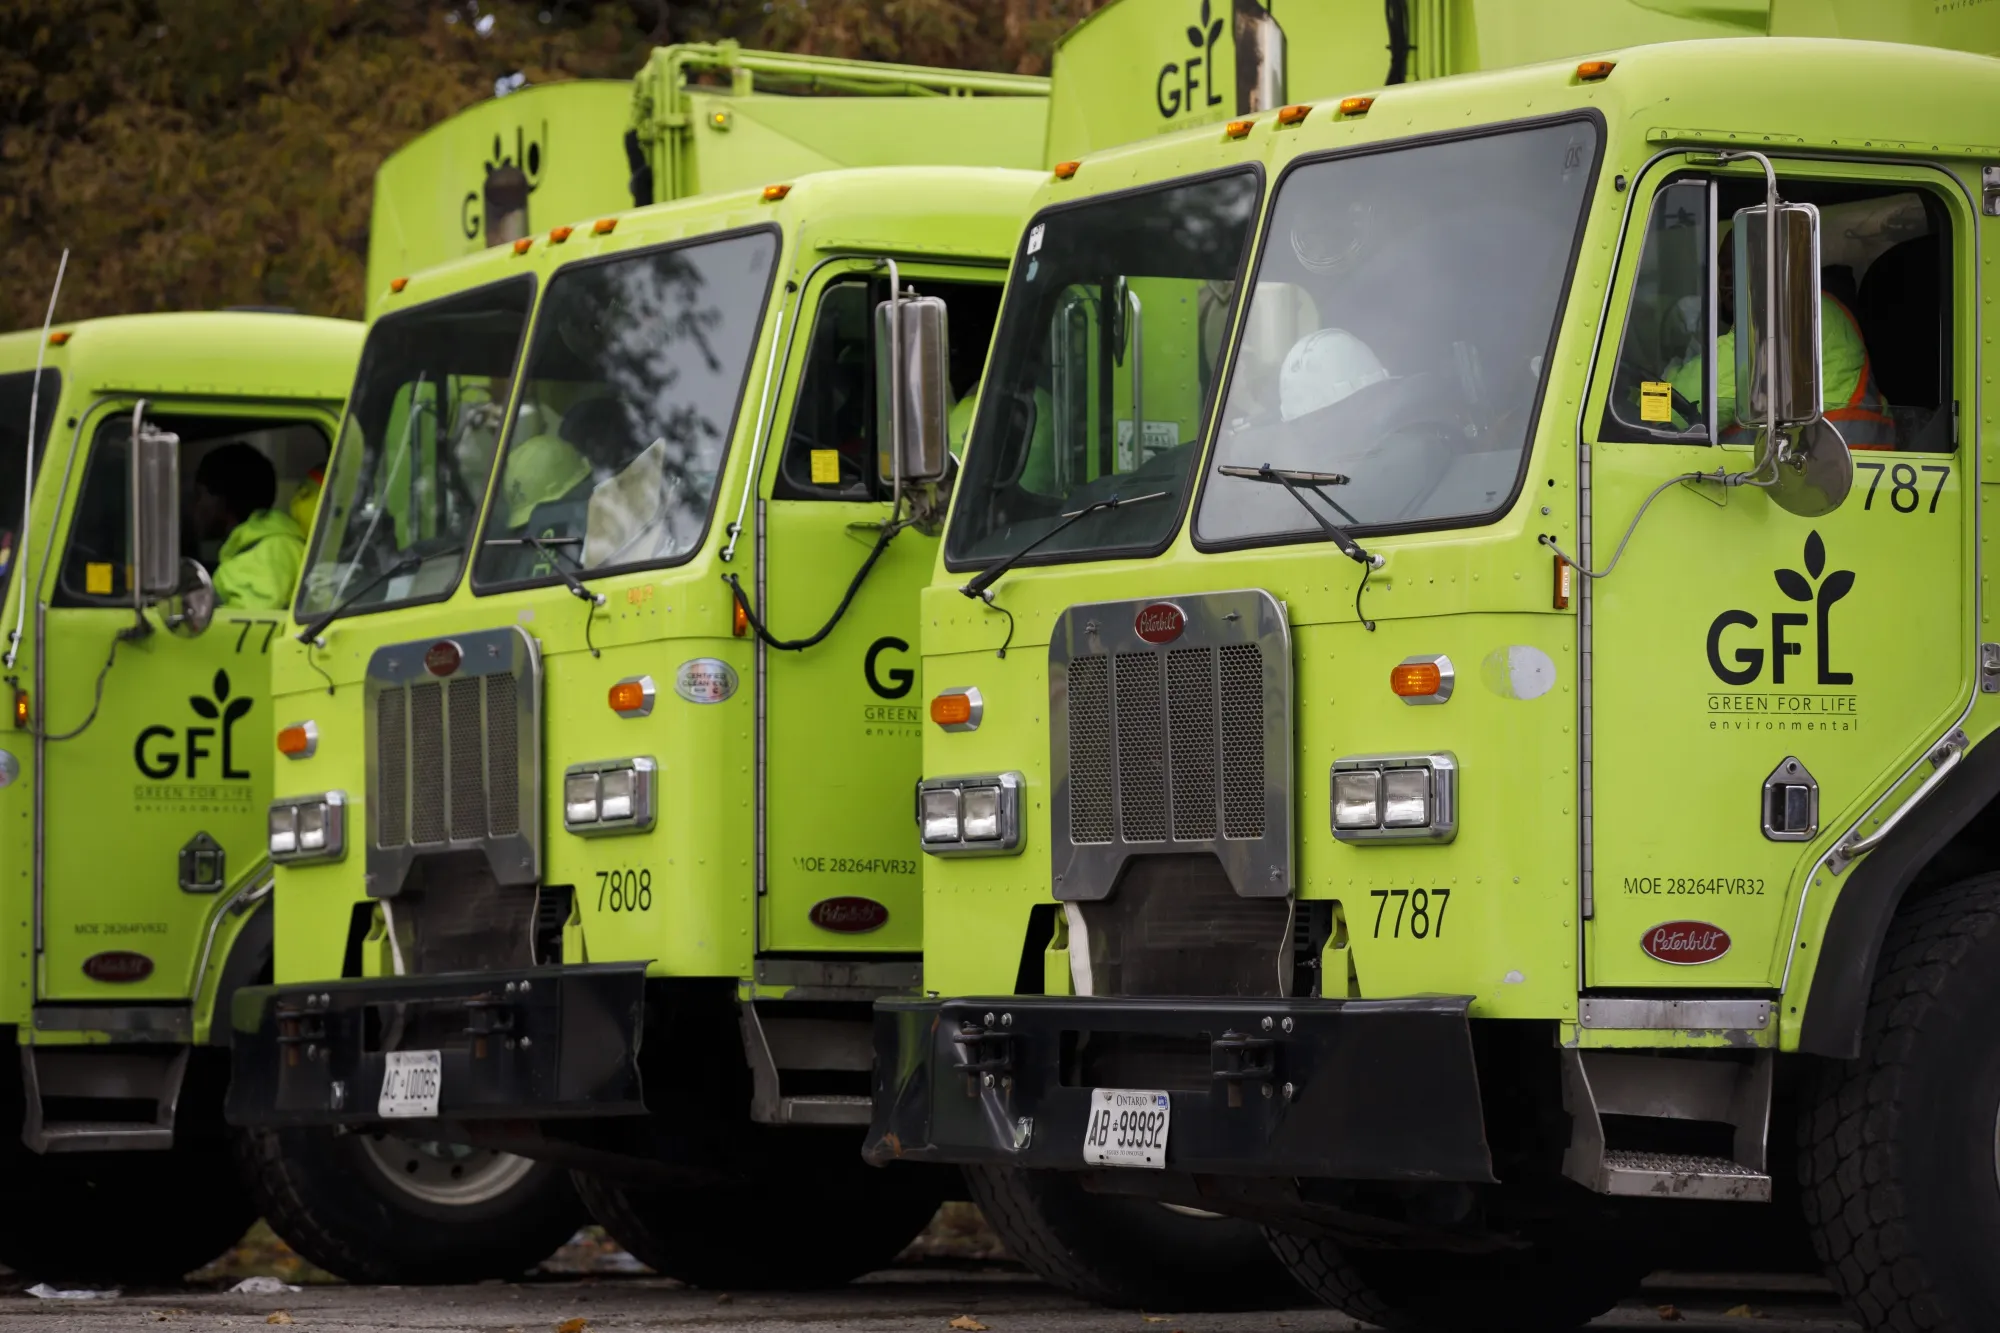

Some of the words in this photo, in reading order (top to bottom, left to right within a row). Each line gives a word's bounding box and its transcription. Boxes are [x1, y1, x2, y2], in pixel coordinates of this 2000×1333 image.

[1157, 18, 1224, 119] GFL
[1856, 462, 1950, 513] 787
[230, 618, 286, 654] 77
[1140, 611, 1180, 635] Peterbilt
[1706, 570, 1856, 685] GFL
[864, 707, 918, 720] GREEN
[1708, 696, 1768, 711] GREEN
[1778, 697, 1811, 711] FOR
[1821, 698, 1857, 712] LIFE
[134, 696, 254, 780] GFL
[1709, 718, 1858, 731] environmental
[829, 858, 917, 875] 28264FVR32
[596, 868, 652, 913] 7808
[1624, 877, 1662, 894] MOE
[1666, 878, 1765, 895] 28264FVR32
[1370, 887, 1450, 939] 7787
[1652, 928, 1724, 952] Peterbilt
[1116, 1094, 1148, 1107] ONTARIO
[1118, 1110, 1165, 1149] 99992
